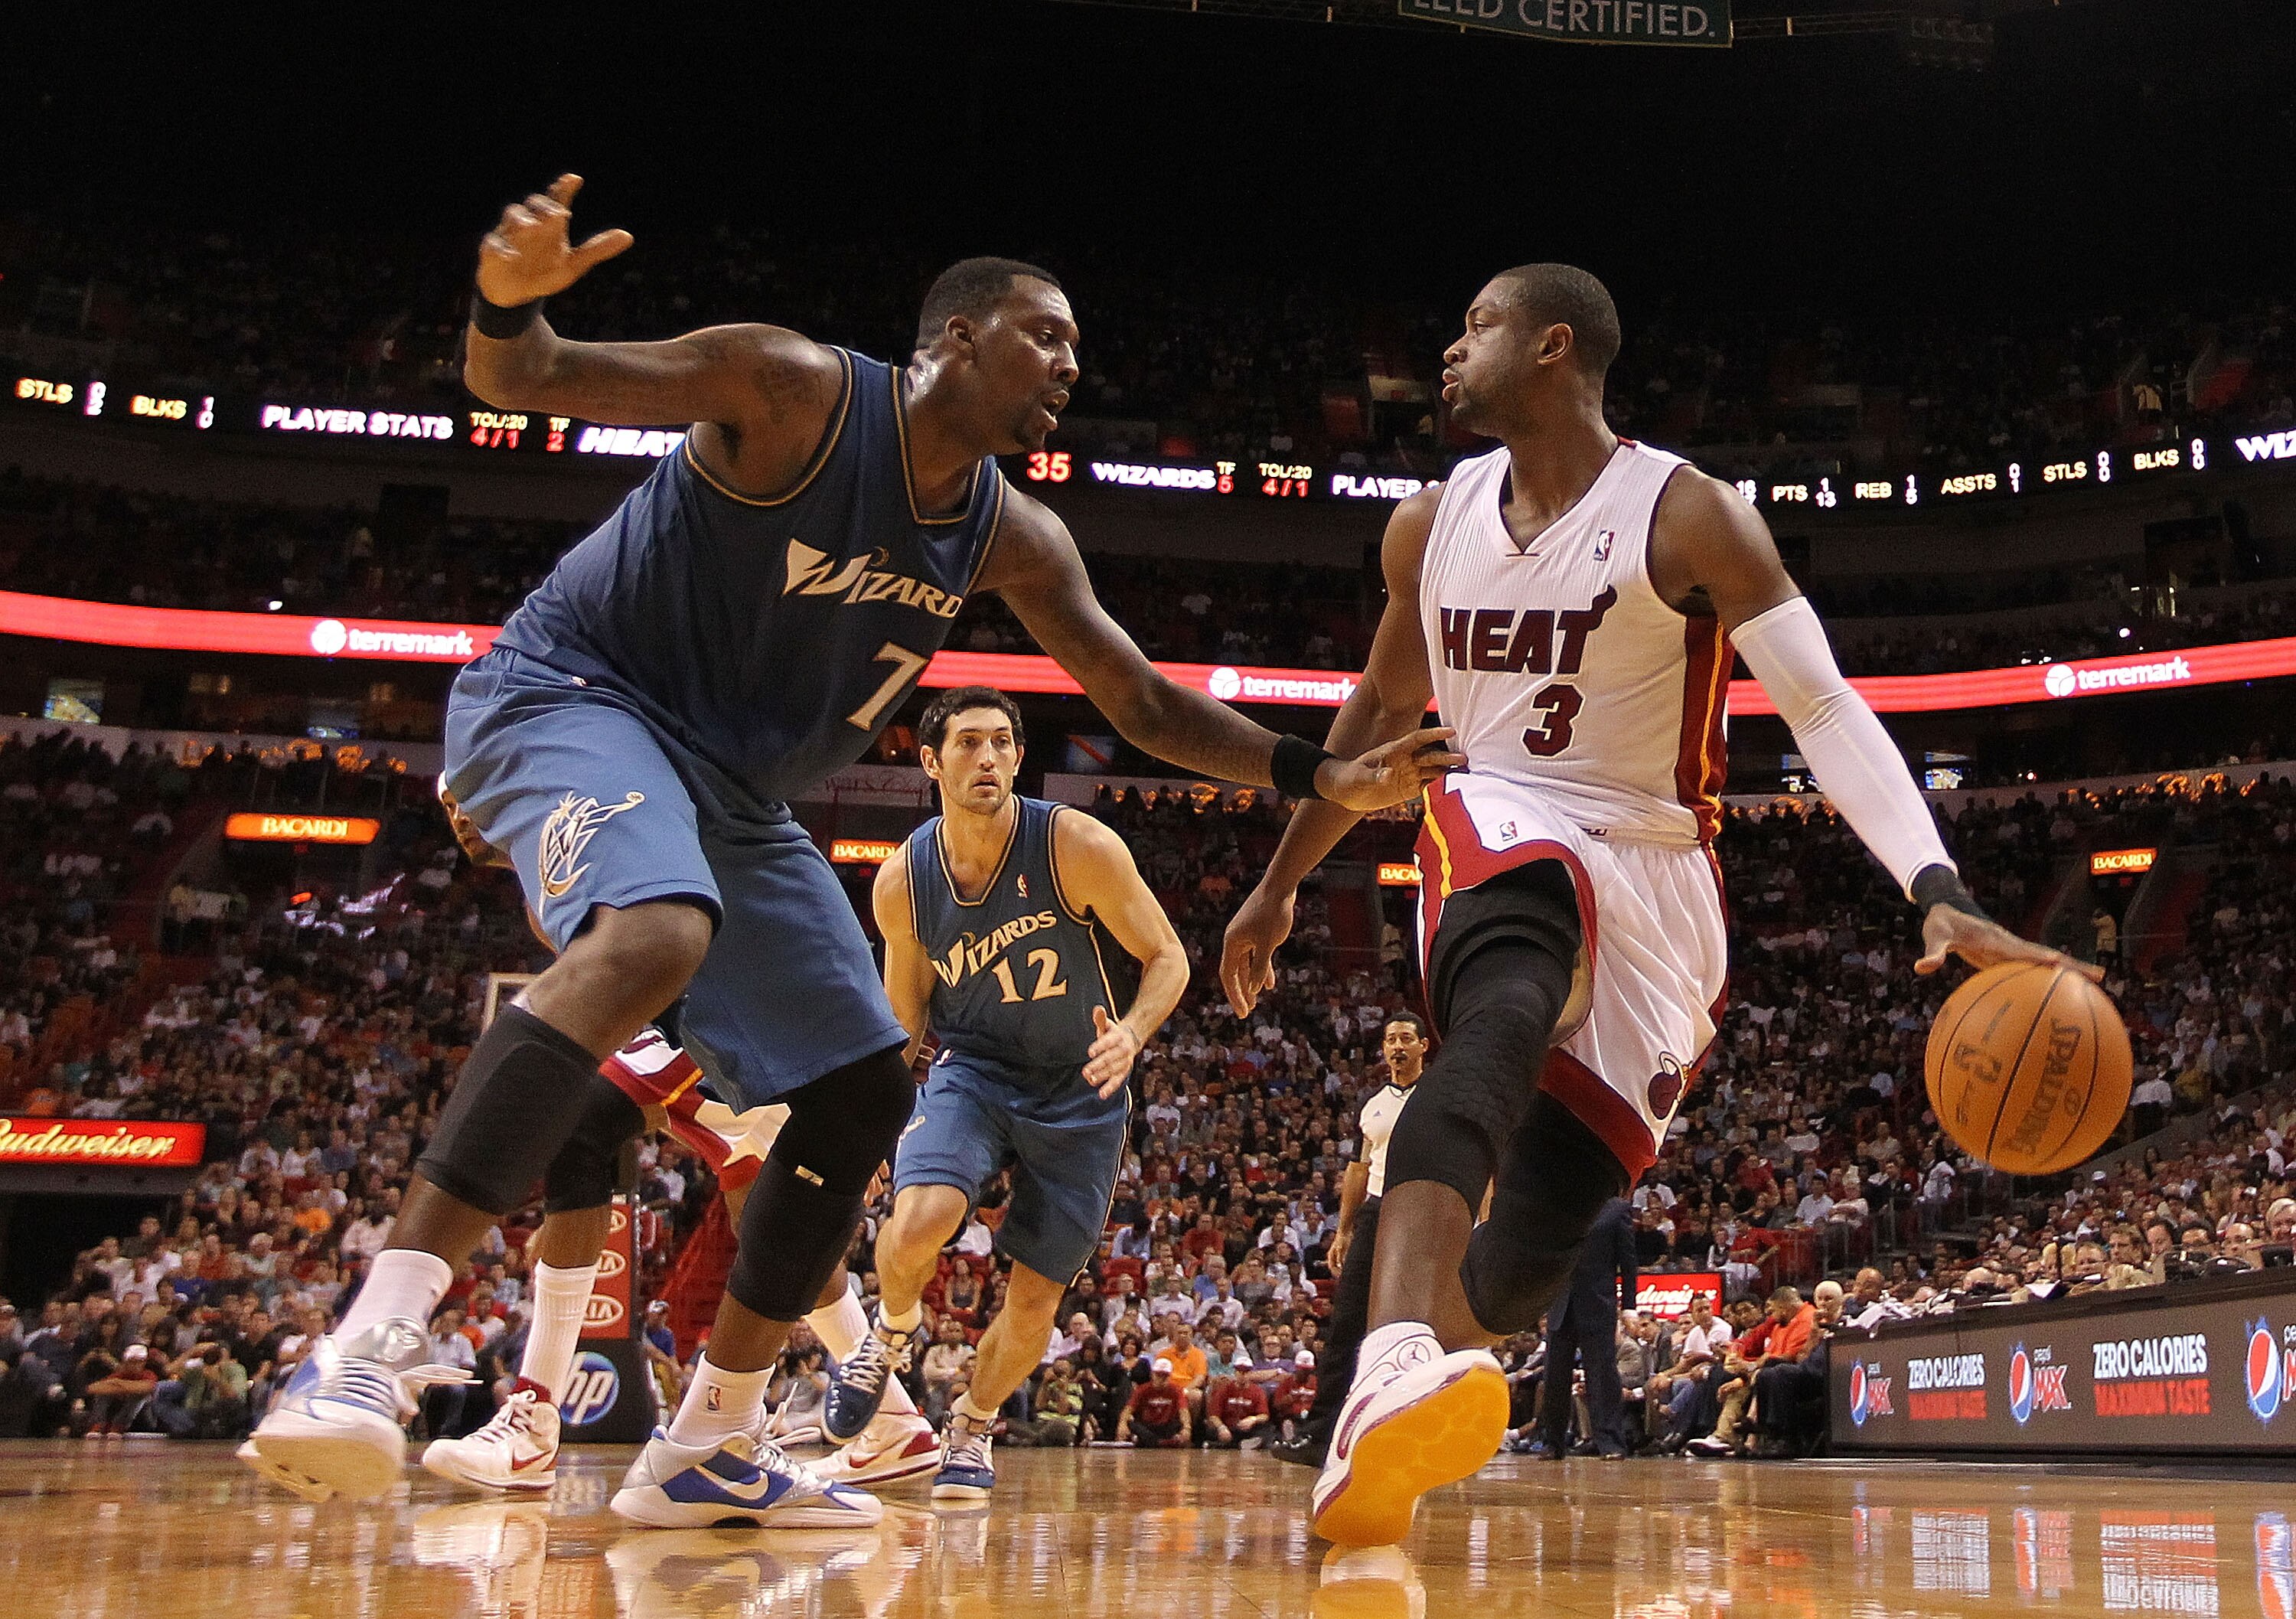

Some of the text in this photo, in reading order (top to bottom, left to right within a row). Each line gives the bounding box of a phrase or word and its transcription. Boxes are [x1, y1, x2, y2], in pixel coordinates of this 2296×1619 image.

[15, 377, 73, 403] STLS
[131, 395, 187, 419] BLKS
[260, 406, 453, 439] PLAYER STATS
[550, 417, 570, 431] TF
[546, 431, 564, 452] 2
[1027, 452, 1071, 482] 35
[1217, 461, 1235, 475] TF
[2043, 461, 2087, 482] STLS
[2134, 449, 2179, 470] BLKS
[1091, 462, 1215, 489] WIZARDS
[1332, 474, 1422, 498] PLAYER
[1941, 473, 1996, 495] ASSTS
[1772, 485, 1808, 501] PTS
[1816, 491, 1836, 508] 13
[1855, 482, 1891, 498] REB
[348, 628, 473, 655] terremark
[1440, 584, 1618, 674] HEAT
[2077, 655, 2191, 690] terremark
[845, 641, 930, 732] 7
[1242, 677, 1357, 700] terremark
[1521, 681, 1585, 758] 3
[261, 817, 349, 837] BACARDI
[2093, 853, 2152, 870] BACARDI
[931, 909, 1058, 988] WIZARDS
[992, 948, 1067, 1003] 12
[2093, 1333, 2207, 1379] ZERO CALORIES
[1908, 1358, 1932, 1389] ZERO
[1933, 1353, 1985, 1387] CALORIES
[566, 1350, 615, 1424] hp
[2033, 1365, 2073, 1412] MAX
